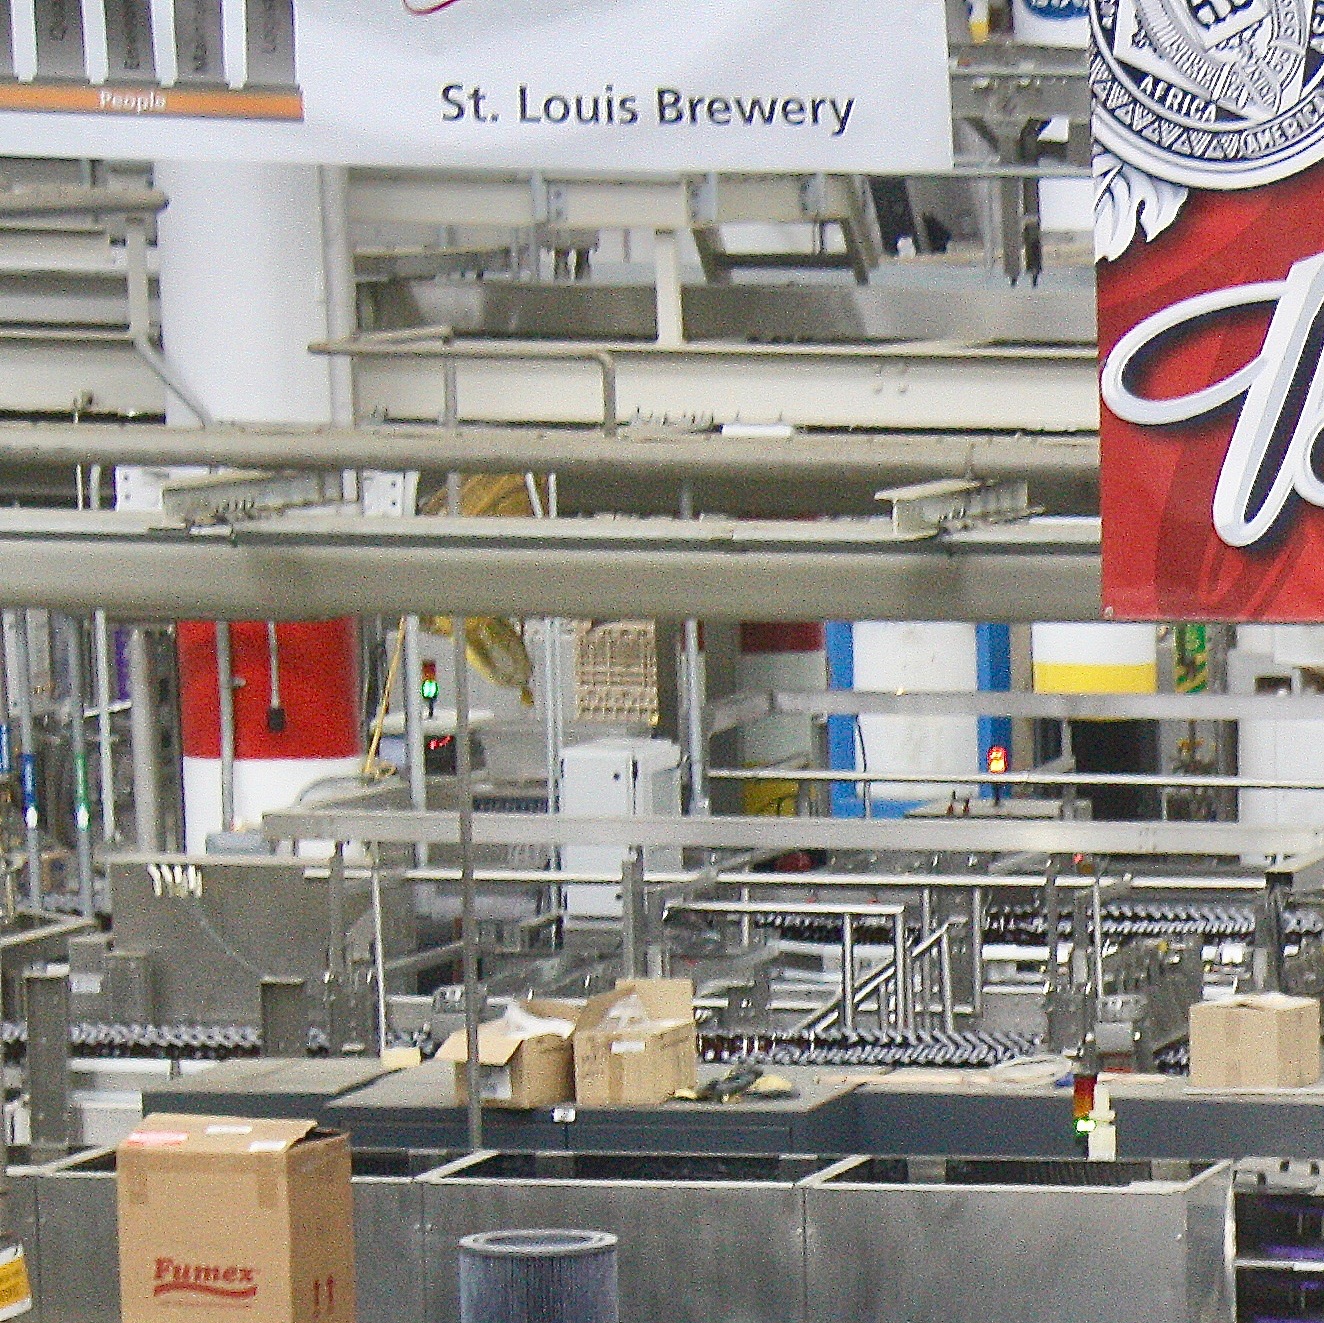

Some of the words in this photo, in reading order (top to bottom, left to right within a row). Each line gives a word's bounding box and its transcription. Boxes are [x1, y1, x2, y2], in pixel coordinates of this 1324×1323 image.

[100, 89, 168, 113] People
[440, 82, 499, 123] St.
[518, 83, 639, 125] Louis
[656, 86, 856, 137] Brewery
[1139, 74, 1218, 124] AFRICA
[153, 1256, 259, 1283] Fumex
